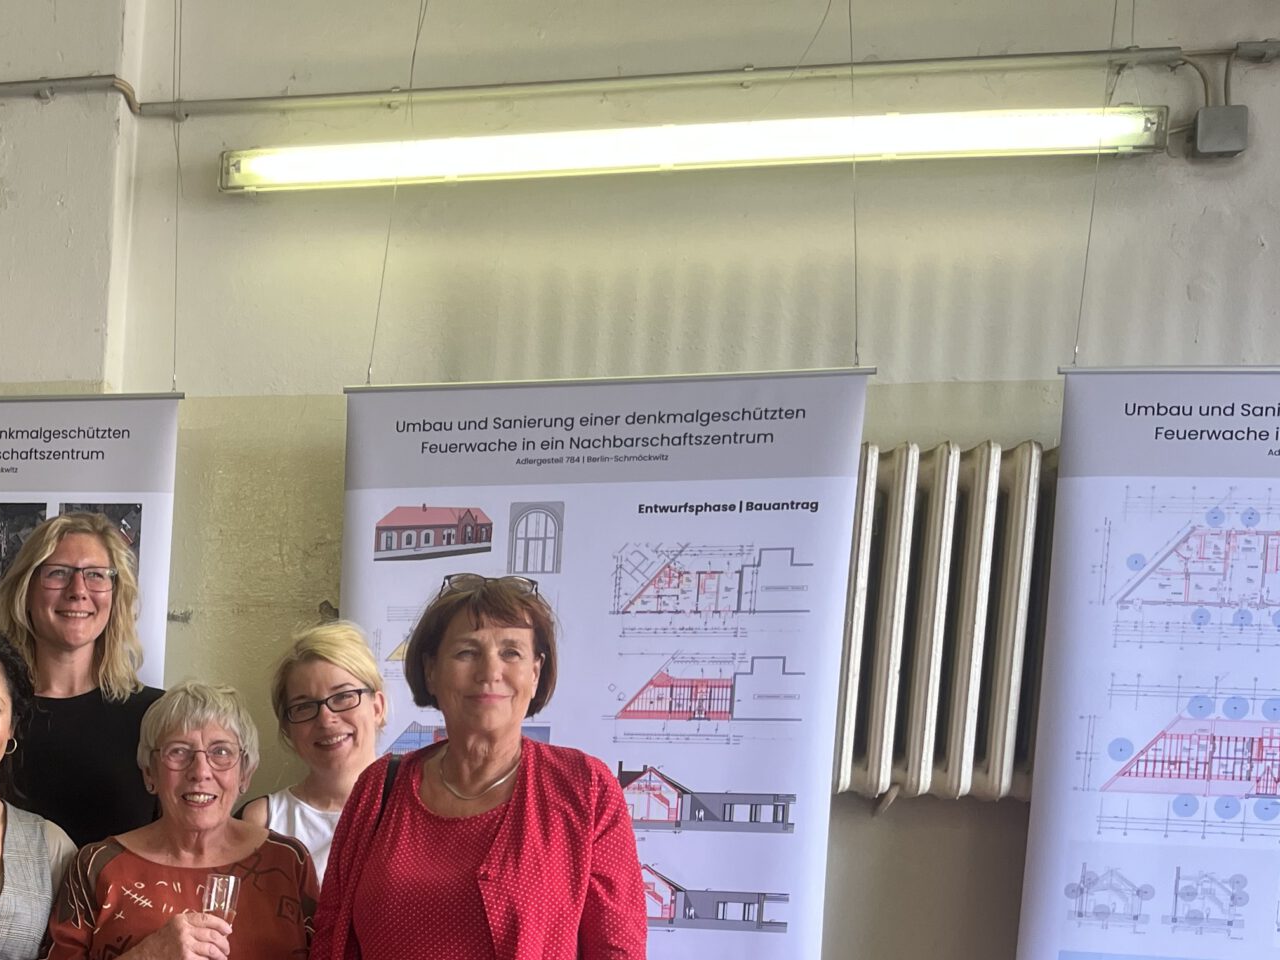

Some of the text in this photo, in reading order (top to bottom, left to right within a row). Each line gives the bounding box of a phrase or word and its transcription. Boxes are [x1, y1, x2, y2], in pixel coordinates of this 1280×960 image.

[1124, 402, 1193, 417] Umbau
[1199, 402, 1235, 417] und
[395, 406, 806, 433] Umbau und Sanierung einer denkmalgeschützten
[1154, 426, 1270, 441] Feuerwache
[420, 431, 774, 454] Feuerwache in ein Nachbarschaftszentrum
[515, 456, 564, 467] Adlergestell
[565, 456, 580, 464] 784
[586, 454, 669, 464] Berlin-Schmöckwitz
[637, 503, 736, 516] Entwurfsphase
[745, 500, 819, 513] Bauantrag
